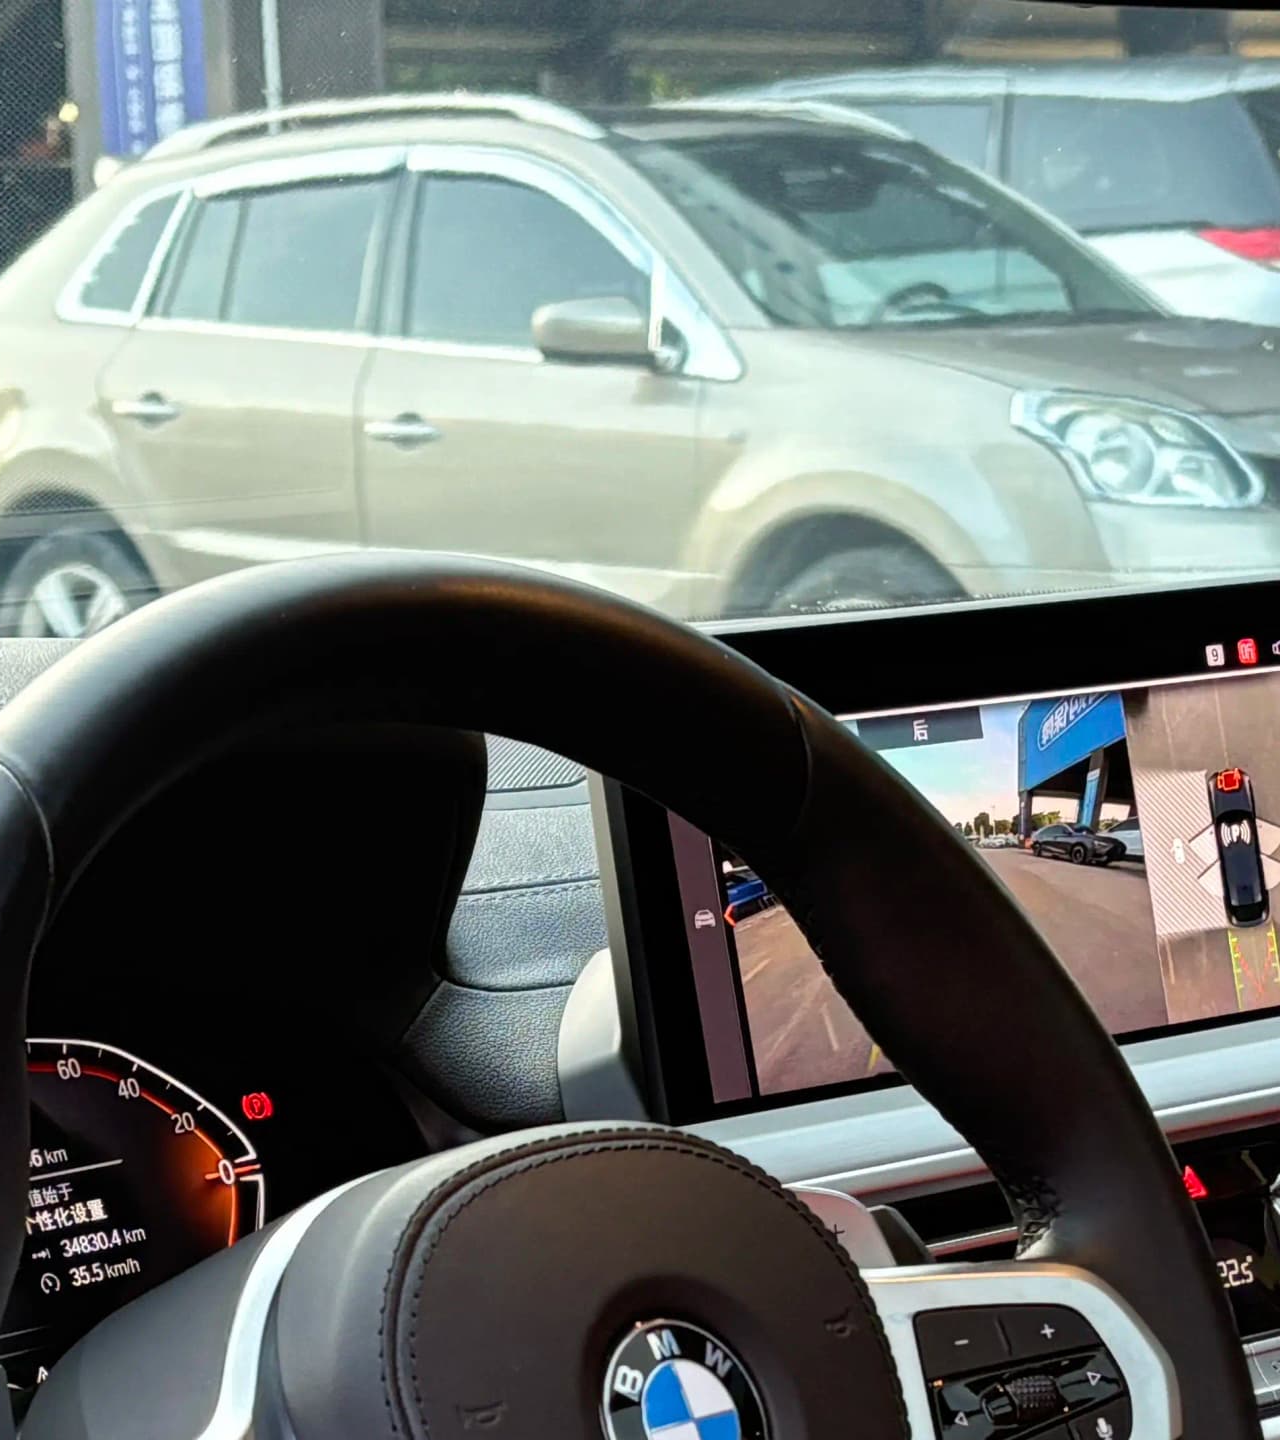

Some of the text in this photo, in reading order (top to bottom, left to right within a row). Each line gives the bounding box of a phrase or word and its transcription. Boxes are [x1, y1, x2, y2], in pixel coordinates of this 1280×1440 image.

[912, 719, 929, 742] 后
[56, 1057, 82, 1080] 60
[117, 1077, 141, 1100] 40
[170, 1111, 195, 1135] 20
[44, 1149, 68, 1164] km
[218, 1159, 235, 1185] 0
[60, 1227, 147, 1257] 34830.4 km
[69, 1258, 141, 1287] 35.5 km/h
[613, 1329, 733, 1403] BMW
